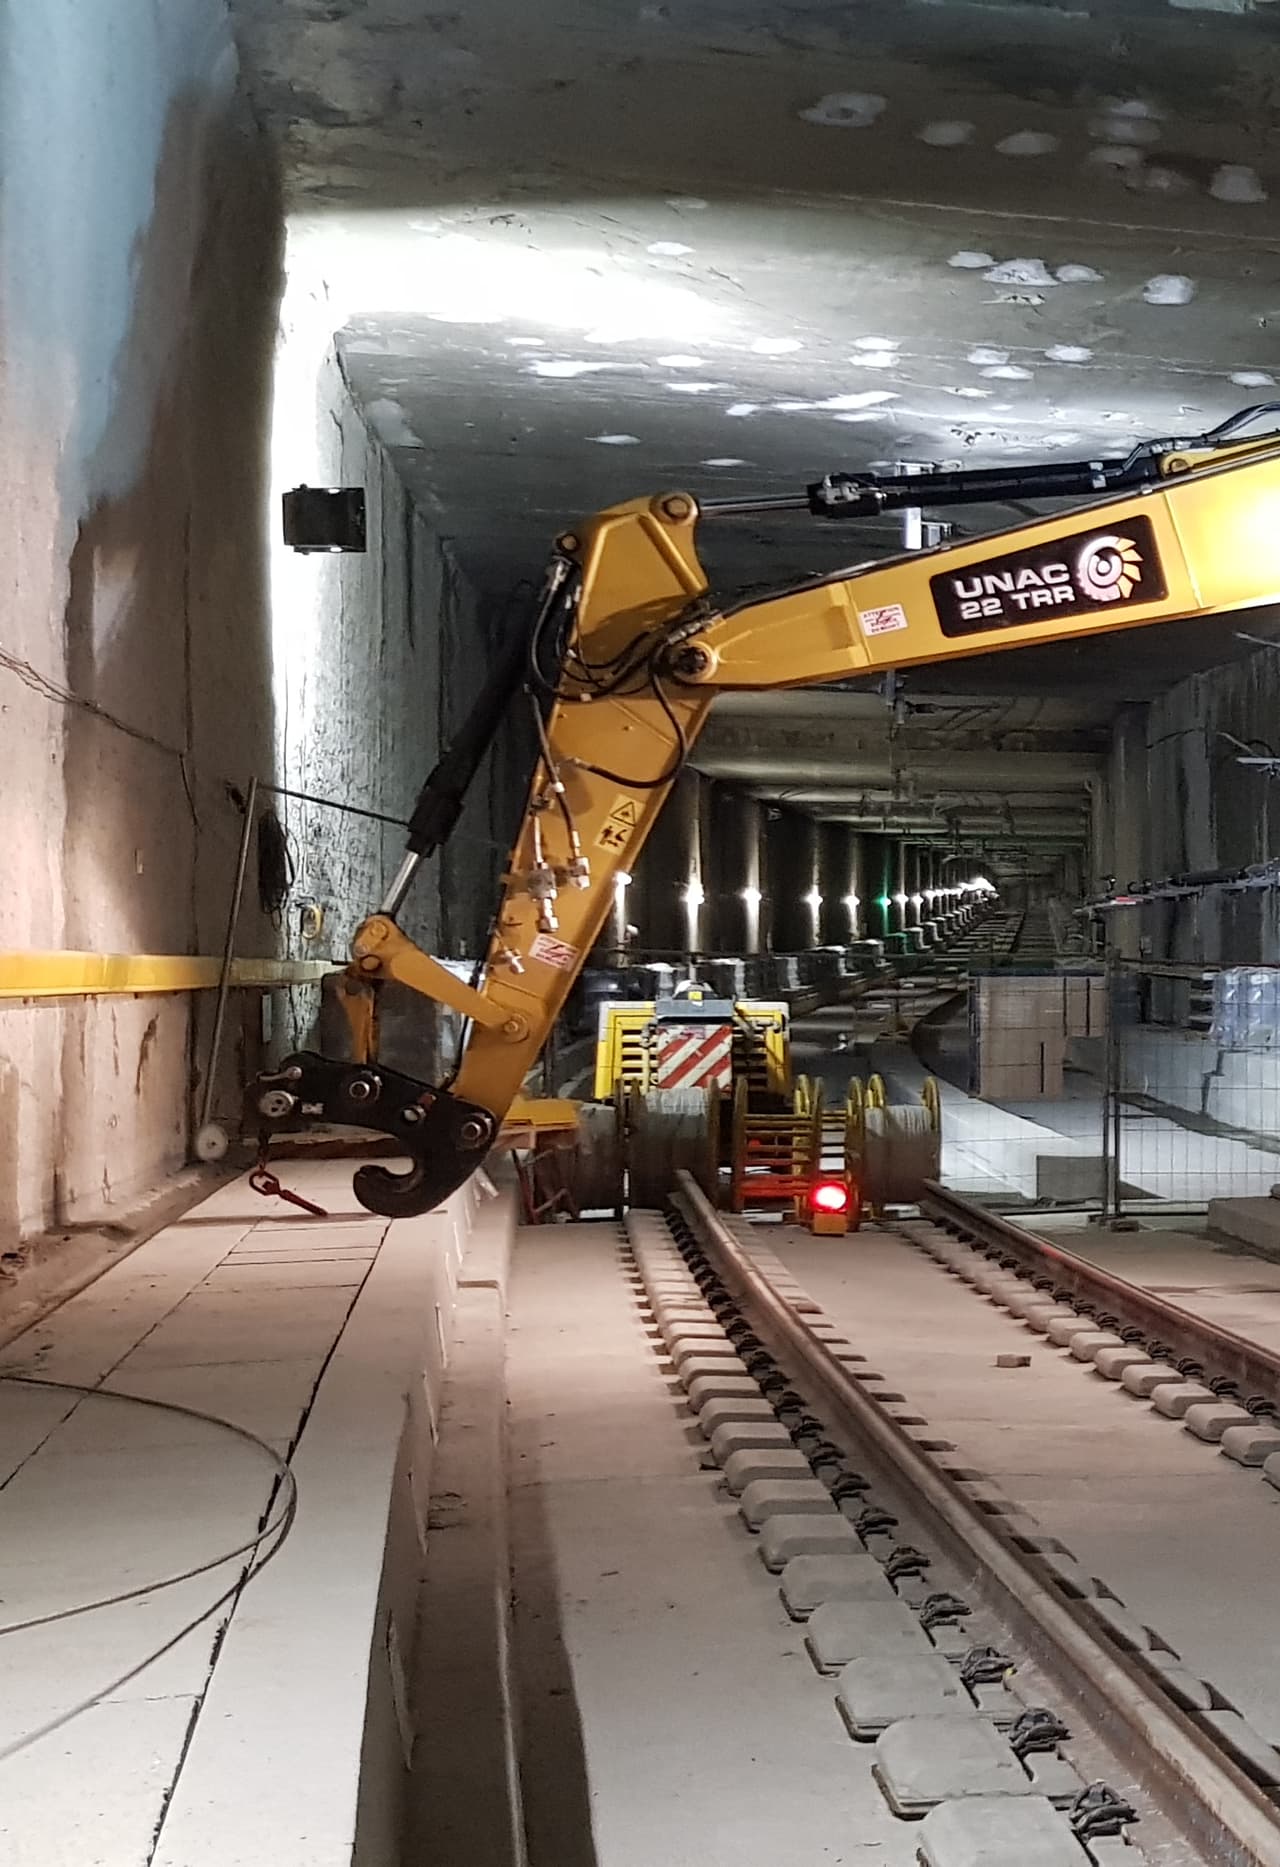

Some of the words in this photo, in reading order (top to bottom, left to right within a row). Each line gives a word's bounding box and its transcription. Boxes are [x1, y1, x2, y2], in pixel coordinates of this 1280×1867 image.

[954, 562, 1071, 599] UNAC
[960, 597, 1003, 620] 22
[1011, 584, 1076, 610] TRR
